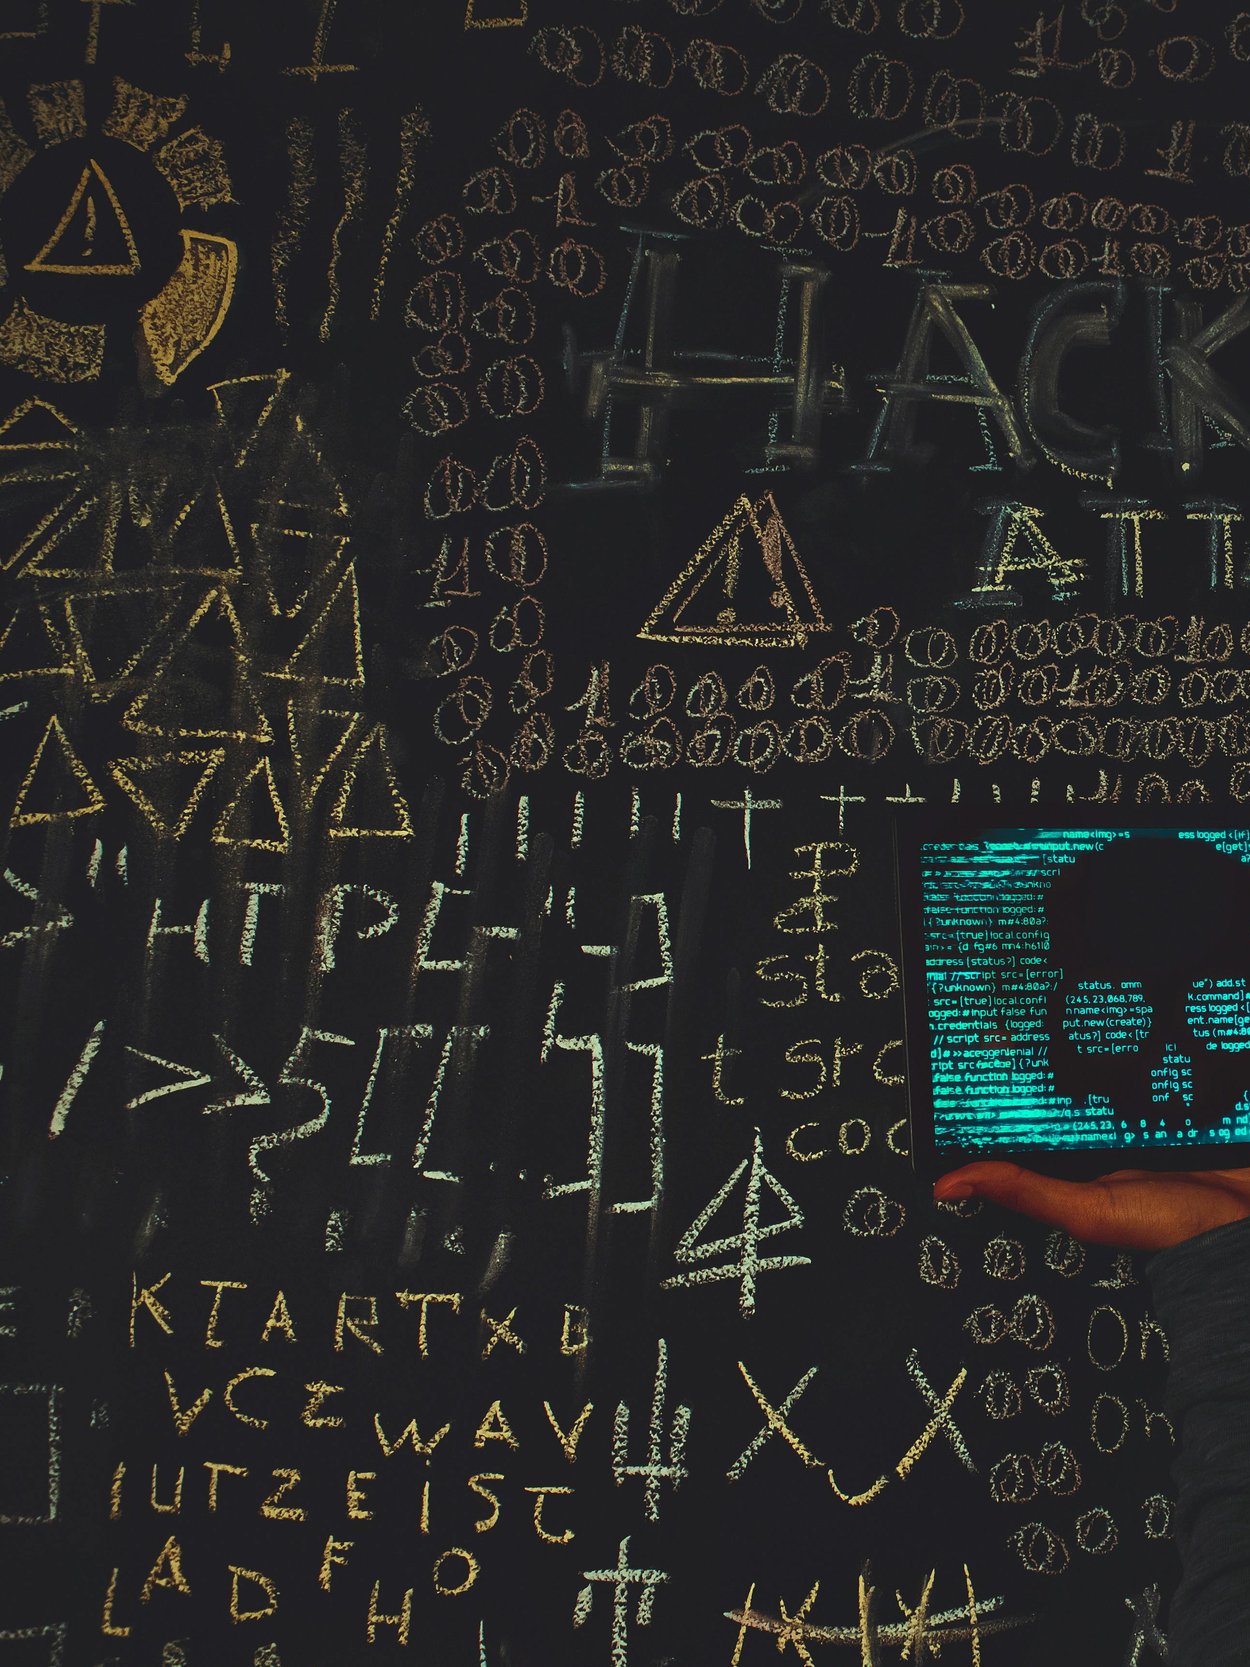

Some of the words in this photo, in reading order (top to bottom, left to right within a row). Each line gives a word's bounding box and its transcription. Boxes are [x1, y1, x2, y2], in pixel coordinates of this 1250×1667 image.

[1208, 1003, 1239, 1015] logged
[1010, 1032, 1051, 1042] address
[1220, 1040, 1250, 1053] logged
[1162, 1053, 1192, 1064] statu
